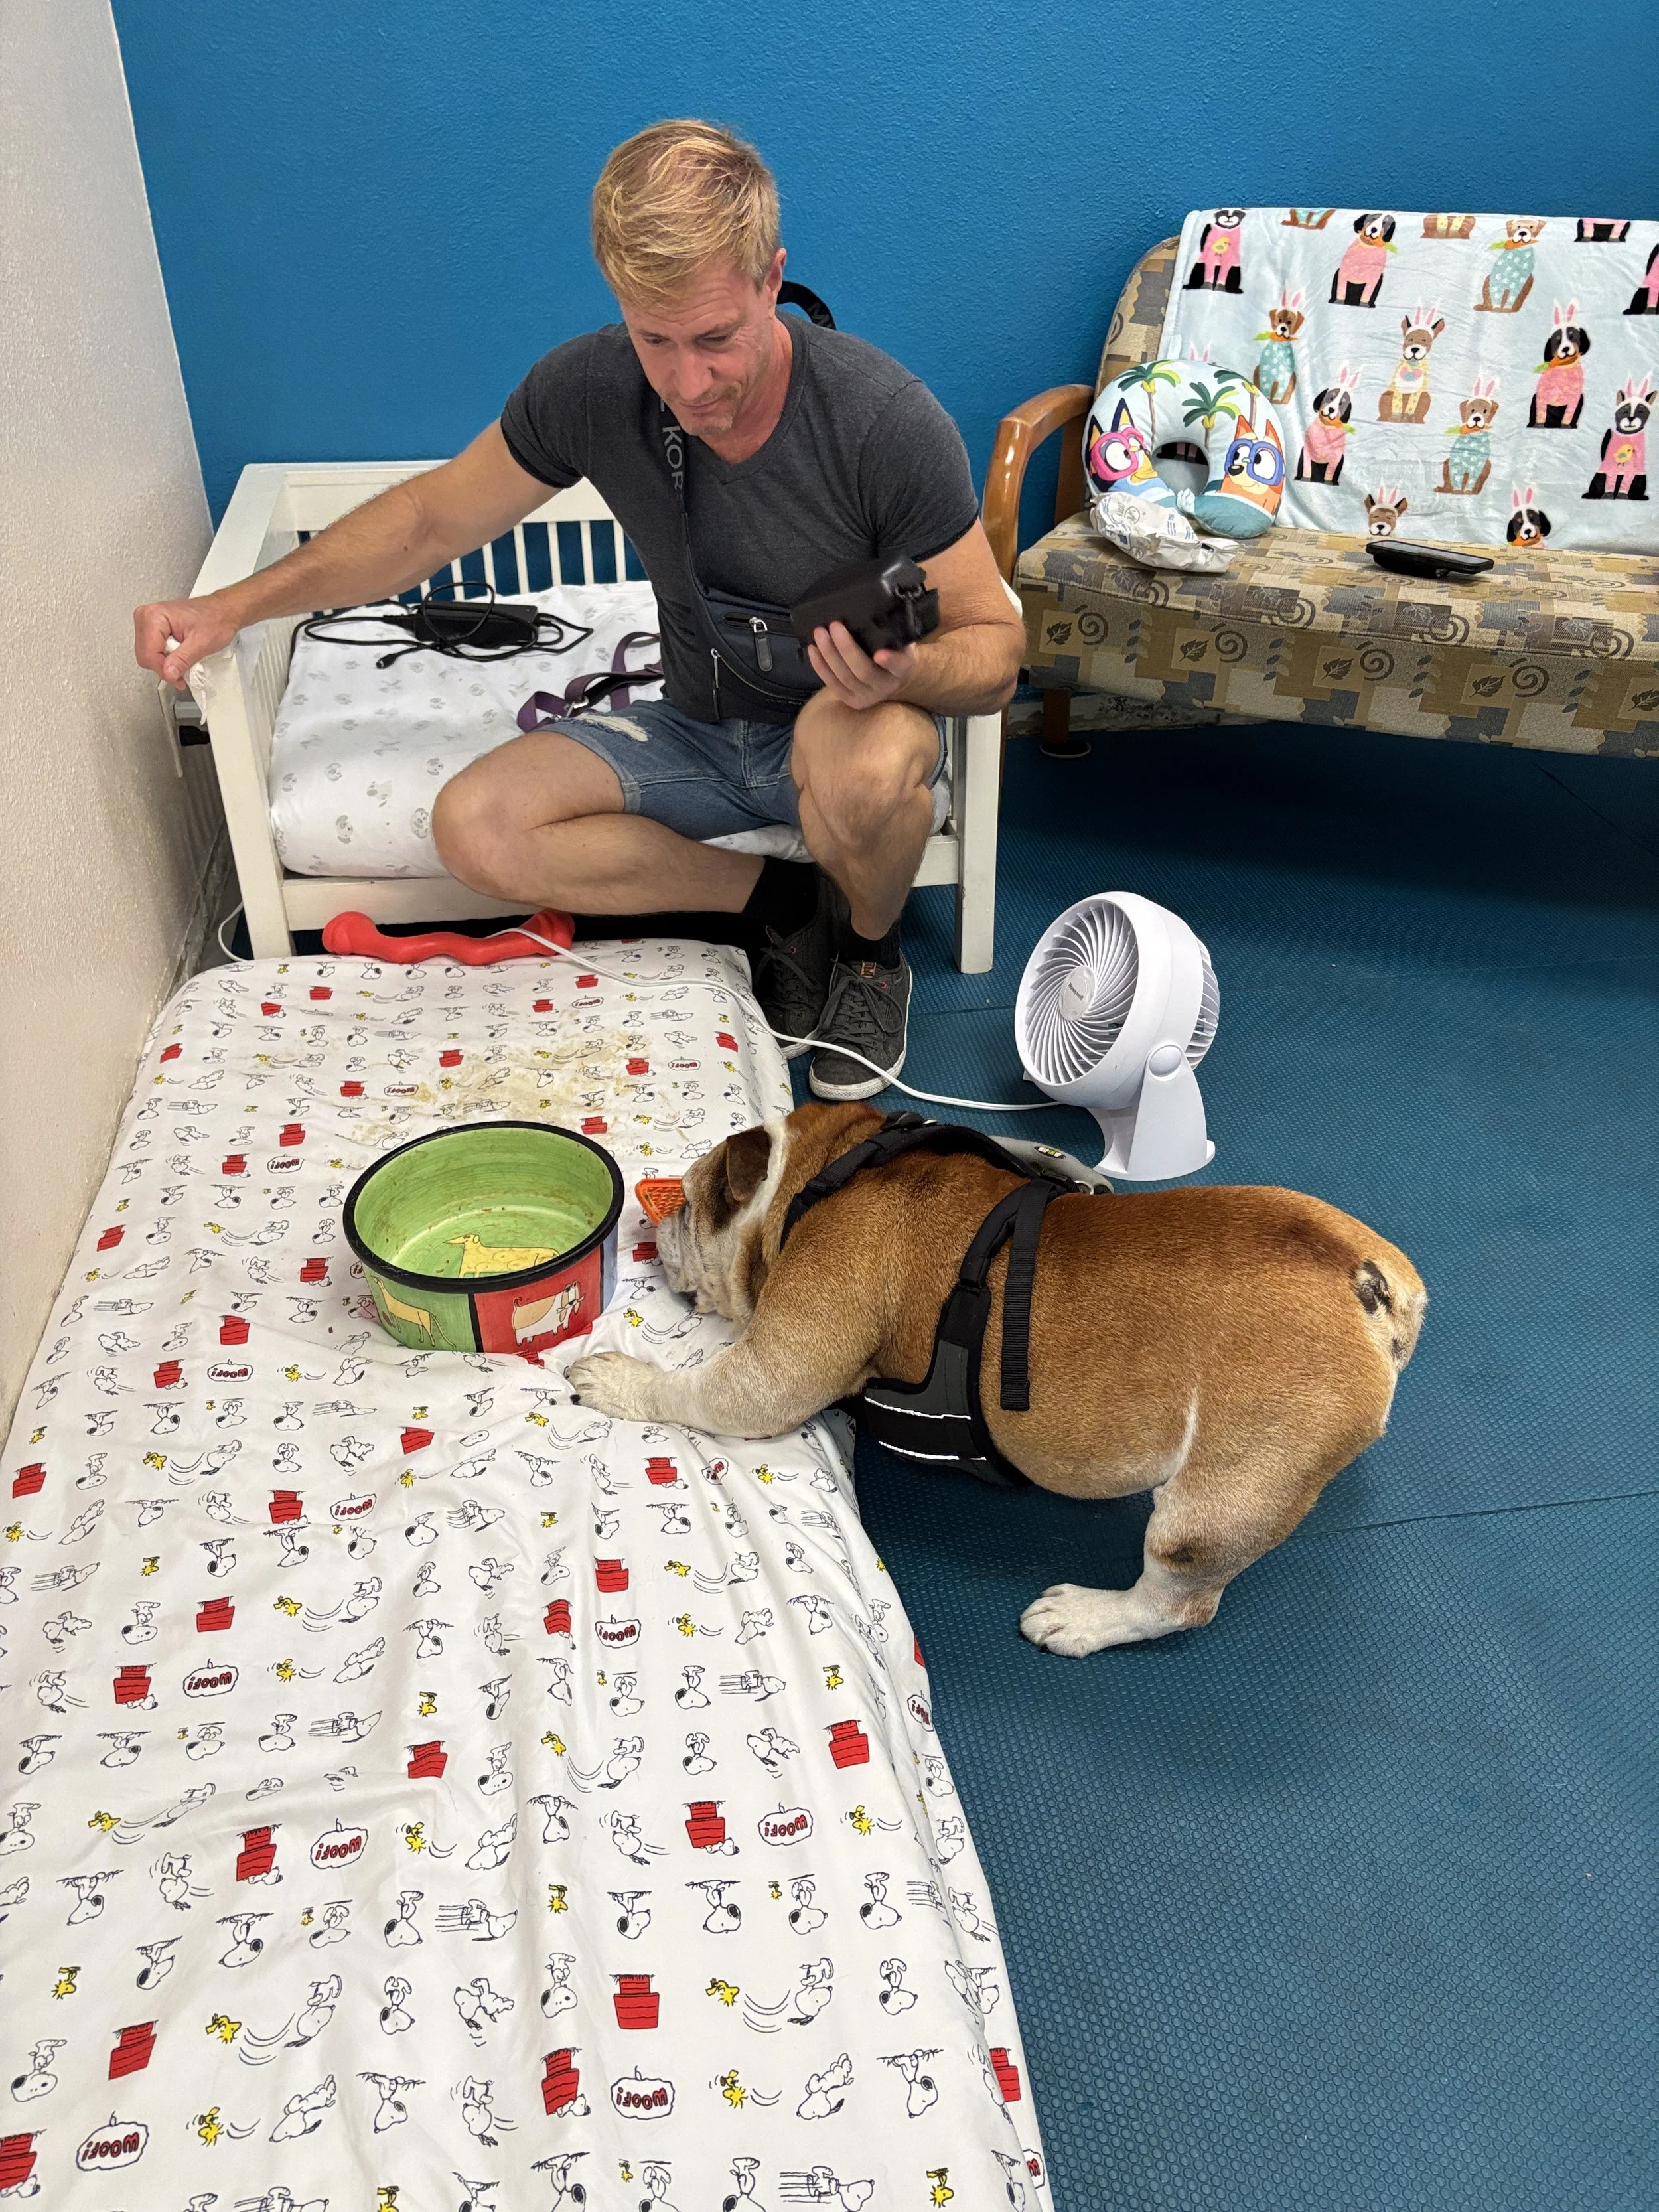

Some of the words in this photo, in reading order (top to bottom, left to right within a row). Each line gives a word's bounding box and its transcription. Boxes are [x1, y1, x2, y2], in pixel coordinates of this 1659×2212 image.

[271, 1159, 300, 1170] WOOF!
[211, 1367, 249, 1379] WOOF!
[335, 1498, 372, 1516] WOOF!
[599, 1623, 636, 1642] WOOF!
[187, 1671, 232, 1691] WOOF!
[765, 1814, 808, 1838] WOOF!
[315, 1835, 362, 1860] WOOF!
[616, 2086, 668, 2110] WOOF!
[81, 2131, 139, 2162] WOOF!
